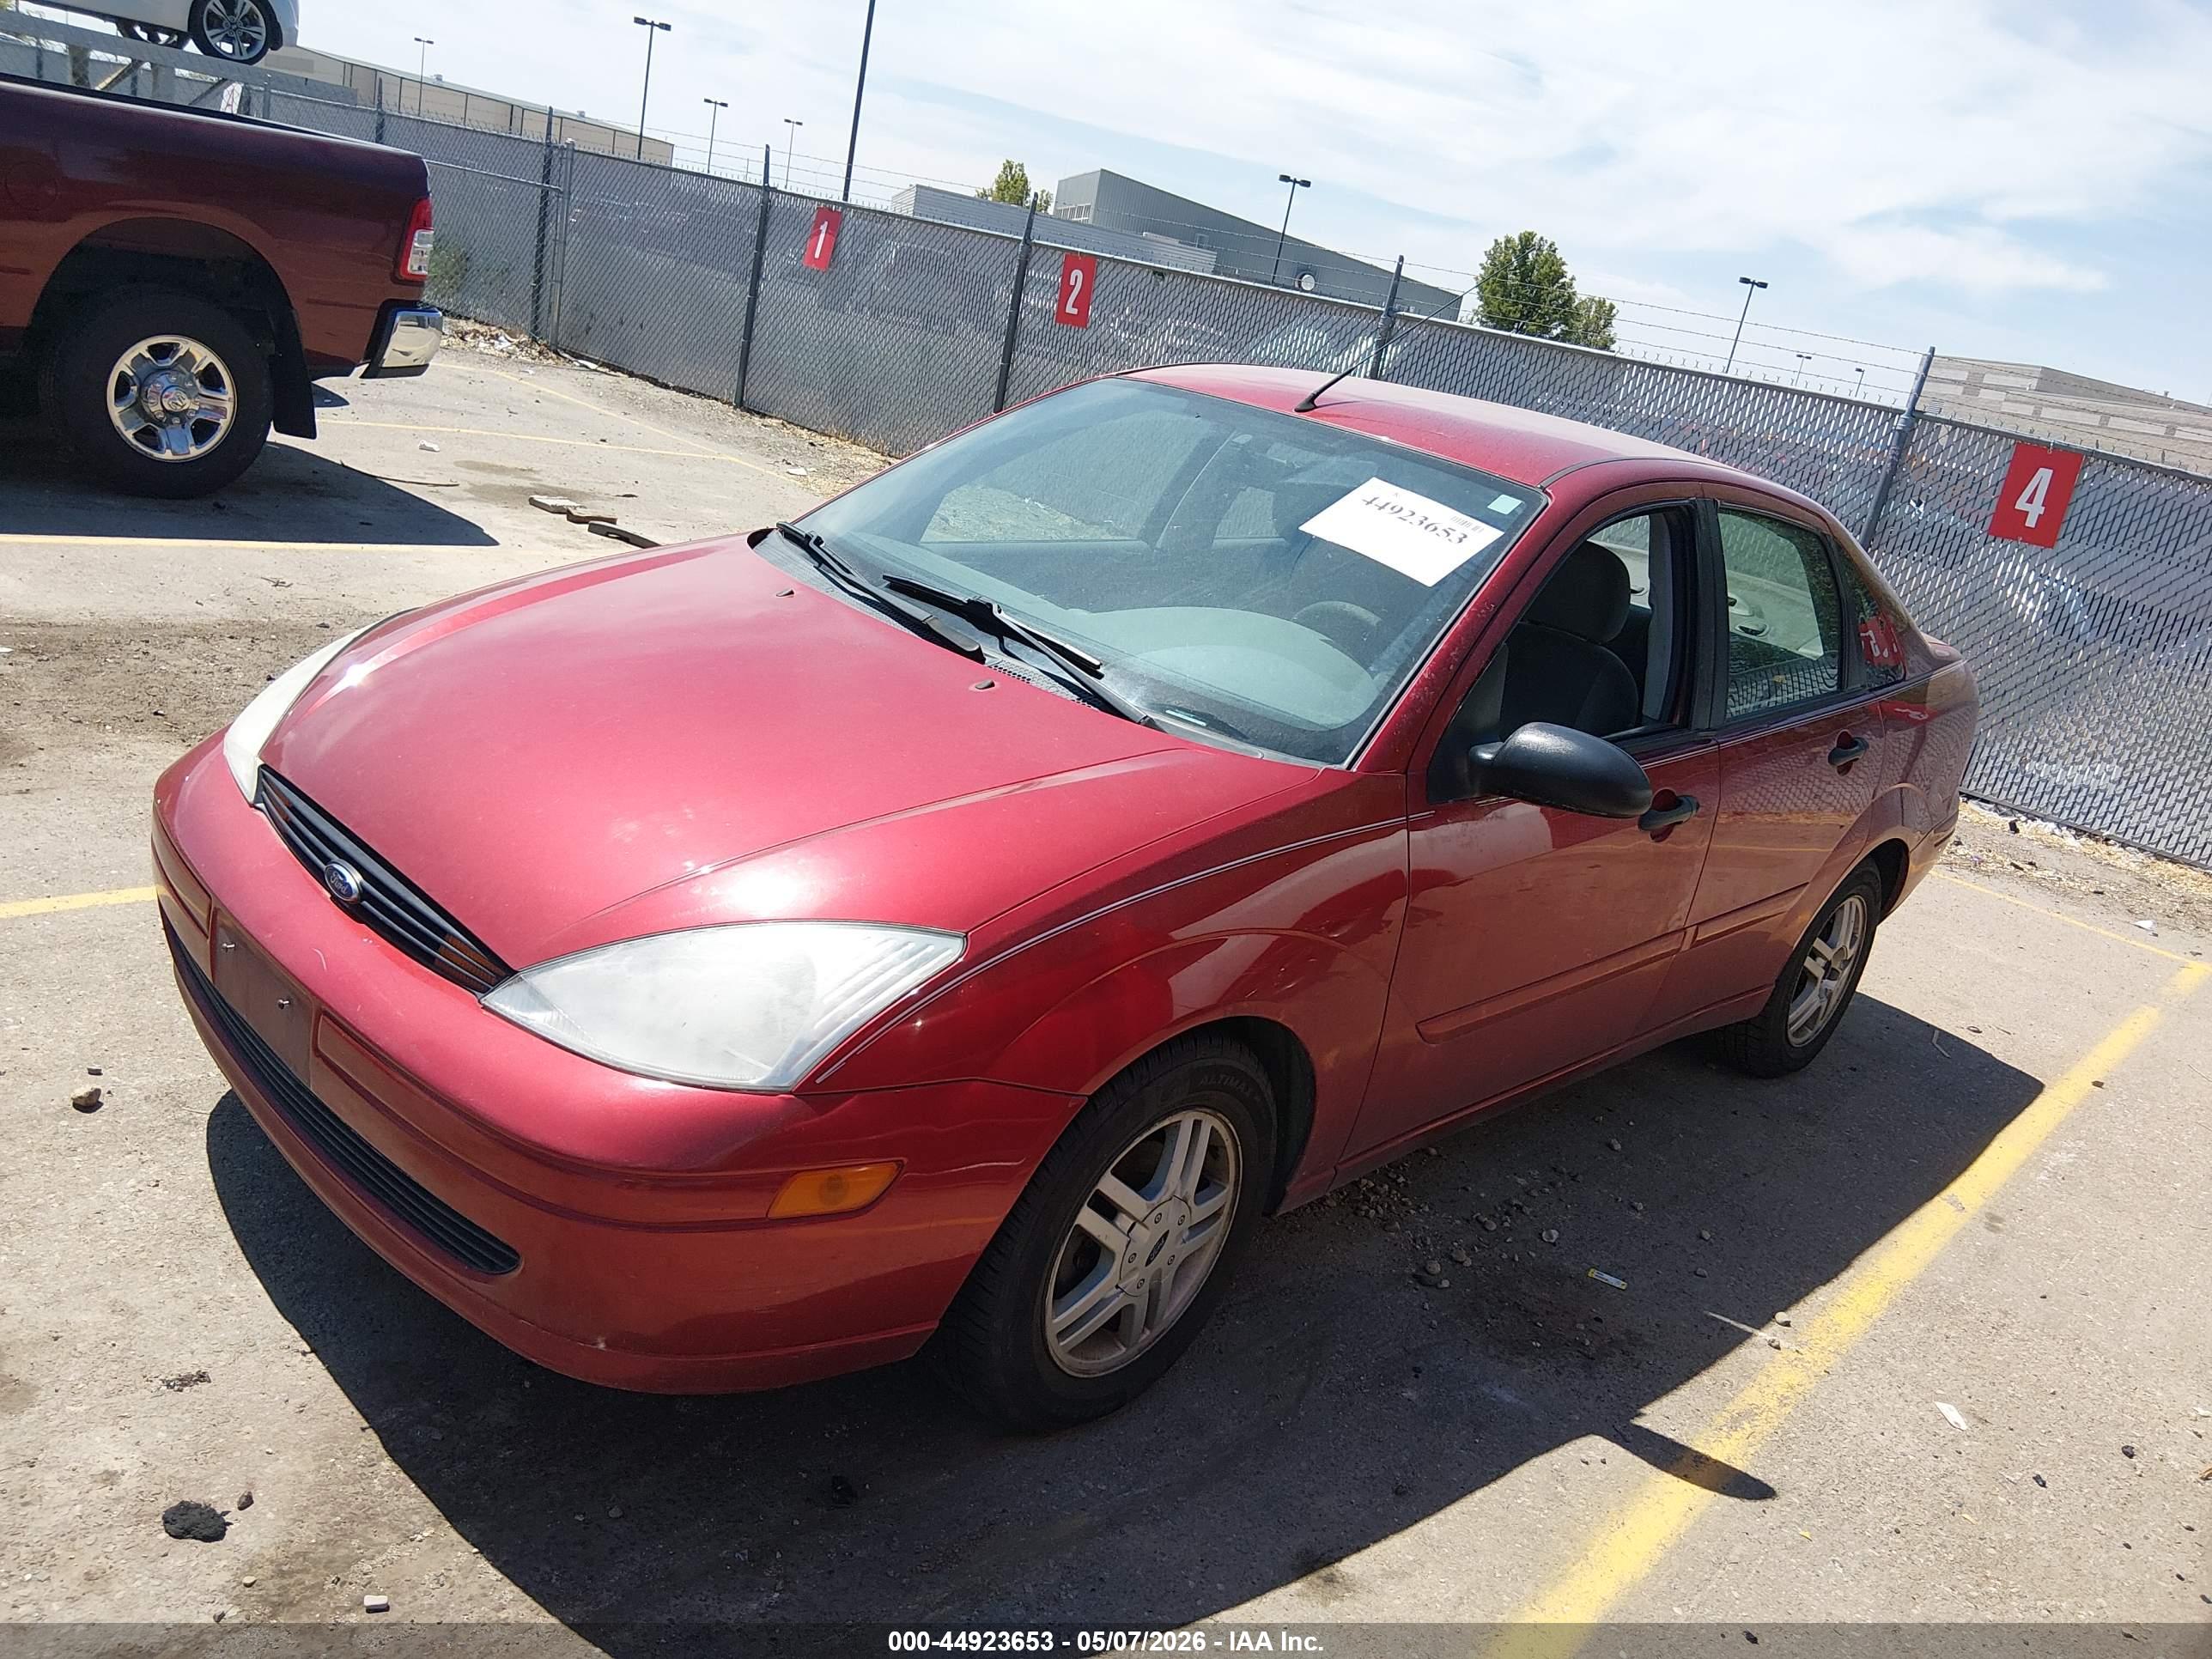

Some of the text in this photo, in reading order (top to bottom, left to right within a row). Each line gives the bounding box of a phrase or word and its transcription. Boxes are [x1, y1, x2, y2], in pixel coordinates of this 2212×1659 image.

[814, 221, 828, 258] 1
[1066, 269, 1083, 315] 2
[1362, 496, 1468, 544] 44923653
[2014, 467, 2053, 528] 4
[330, 870, 349, 894] Ford
